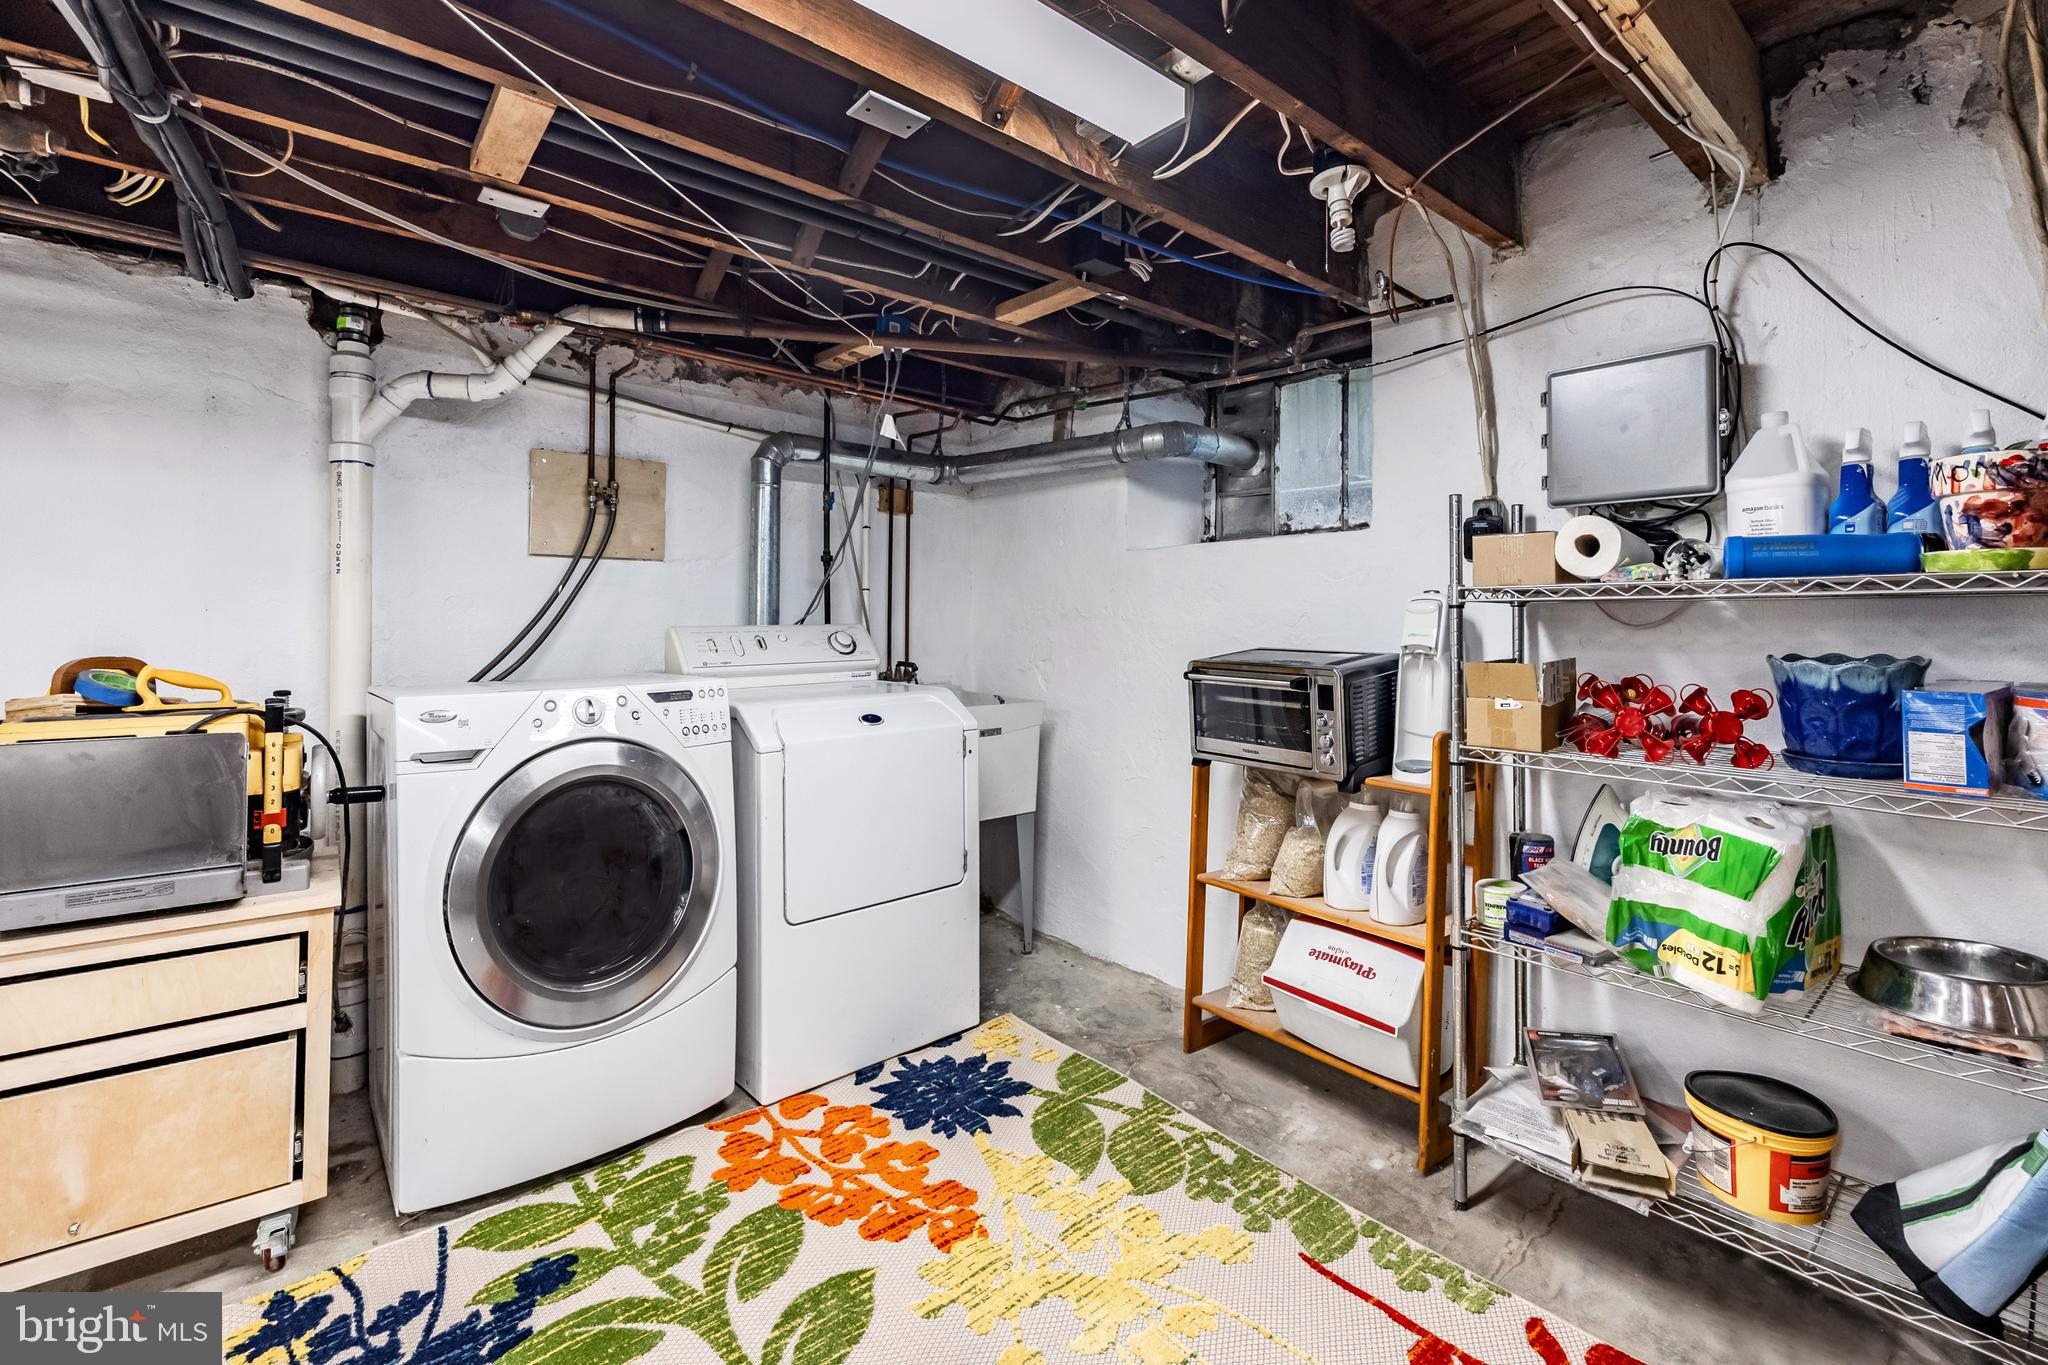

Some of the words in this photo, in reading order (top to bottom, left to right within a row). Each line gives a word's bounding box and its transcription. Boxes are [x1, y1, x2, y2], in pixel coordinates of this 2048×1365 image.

[1742, 505, 1764, 513] amazon
[1649, 831, 1723, 862] Bounty
[1308, 948, 1377, 980] Playmate
[1662, 943, 1699, 966] Doubles
[1702, 950, 1726, 975] 12
